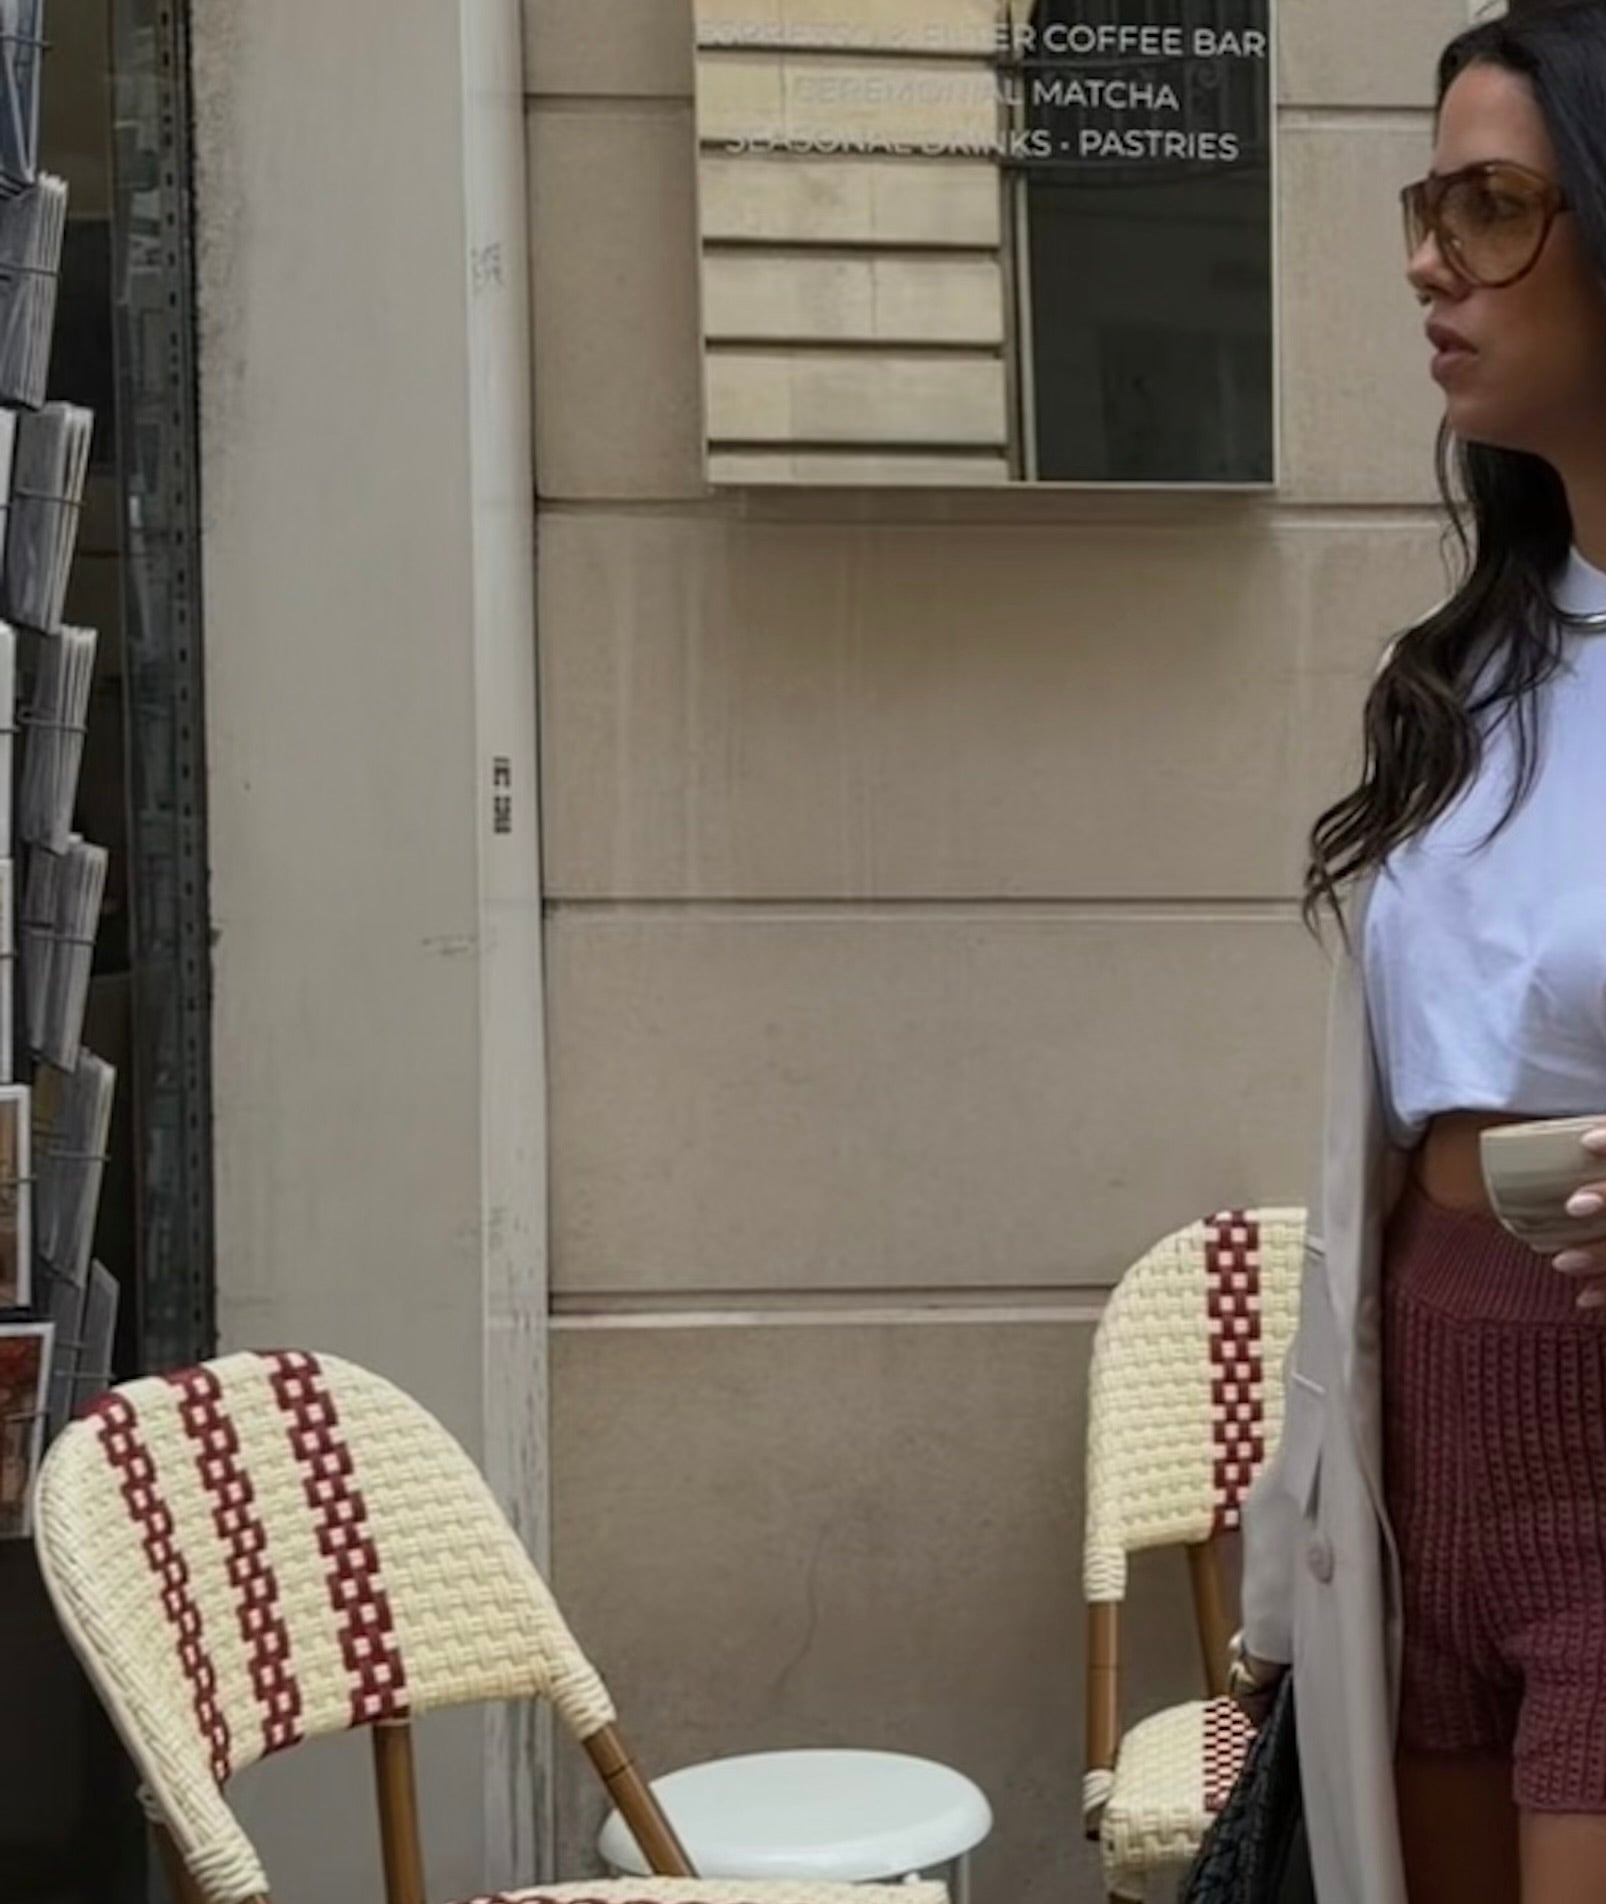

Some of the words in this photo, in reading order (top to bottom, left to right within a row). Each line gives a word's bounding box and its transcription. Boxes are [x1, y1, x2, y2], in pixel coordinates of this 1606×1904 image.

[1042, 23, 1184, 56] COFFEE
[1193, 27, 1266, 58] BAR
[1032, 79, 1180, 111] MATCHA
[922, 126, 1052, 158] DRINKS
[1078, 129, 1240, 163] PASTRIES
